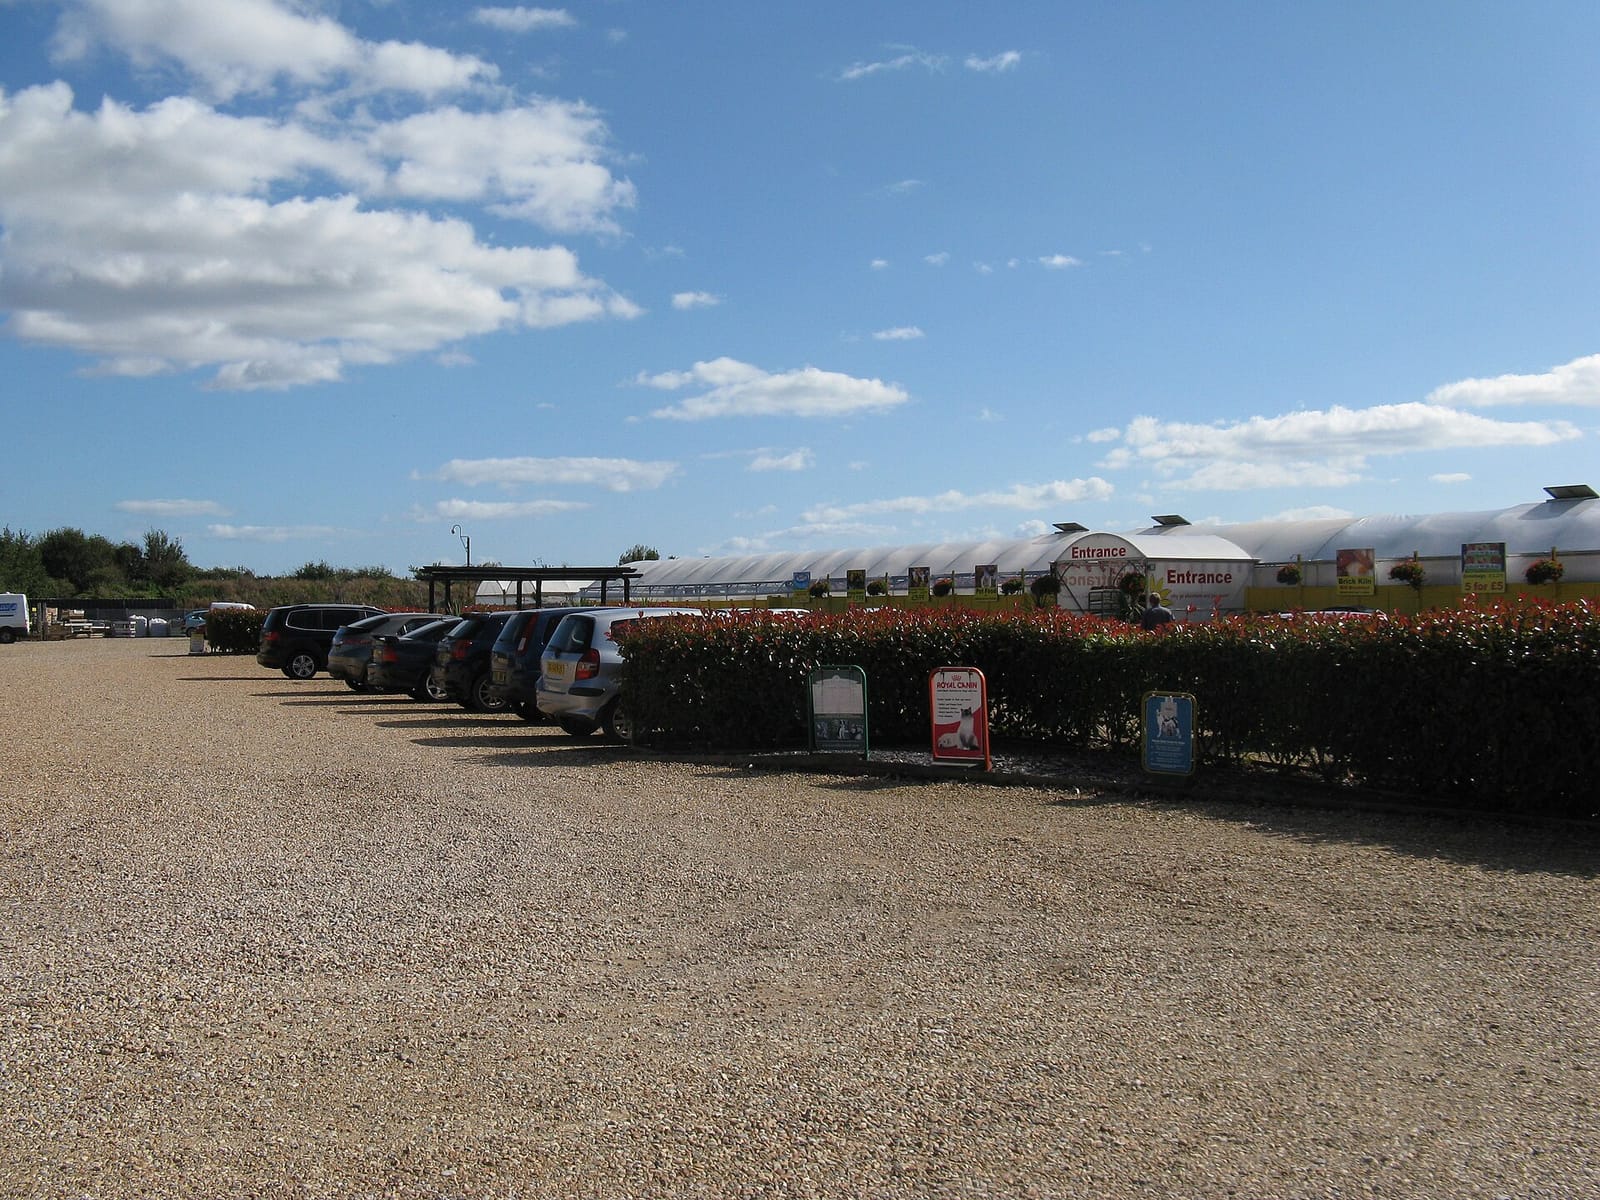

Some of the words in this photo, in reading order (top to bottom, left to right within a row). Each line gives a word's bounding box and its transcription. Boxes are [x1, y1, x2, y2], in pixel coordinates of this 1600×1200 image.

[1071, 547, 1126, 559] Entrance
[1166, 569, 1233, 584] Entrance
[1464, 582, 1472, 591] 5
[1474, 581, 1488, 591] for
[1491, 581, 1503, 590] £5
